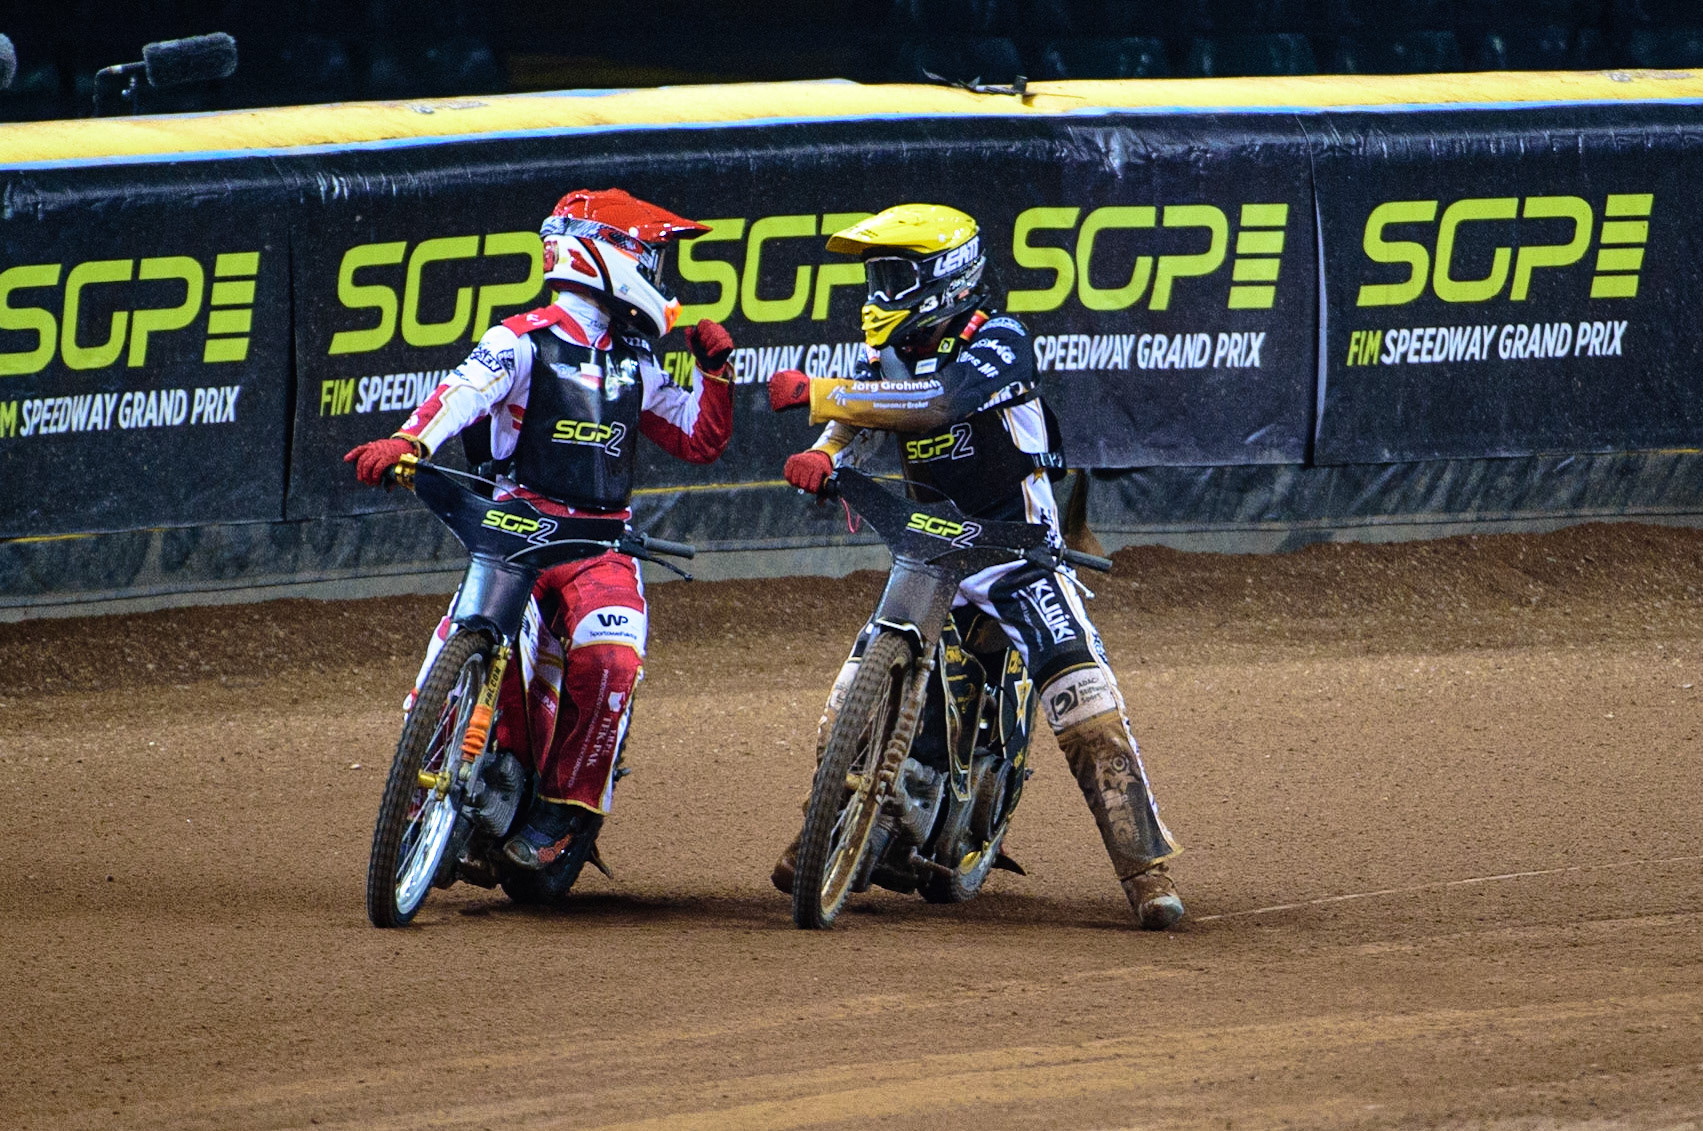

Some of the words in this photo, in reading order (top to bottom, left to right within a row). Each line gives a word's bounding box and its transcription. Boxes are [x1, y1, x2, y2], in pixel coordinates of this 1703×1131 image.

[1034, 334, 1136, 372] SPEEDWAY
[1136, 333, 1212, 370] GRAND
[1213, 331, 1267, 369] PRIX
[1347, 330, 1382, 366] FIM
[1381, 325, 1498, 365] SPEEDWAY
[1498, 322, 1573, 360] GRAND
[1574, 321, 1628, 357] PRIX
[663, 351, 697, 388] FIM
[729, 345, 804, 384] EDWAY
[20, 393, 118, 437] SPEEDWAY
[118, 388, 188, 430] GRAND
[190, 385, 241, 425] PRIX
[320, 378, 355, 417] FIM
[355, 369, 458, 413] SPEEDW
[597, 613, 629, 627] WP
[484, 666, 502, 706] FALCON
[1078, 677, 1099, 688] ADAC
